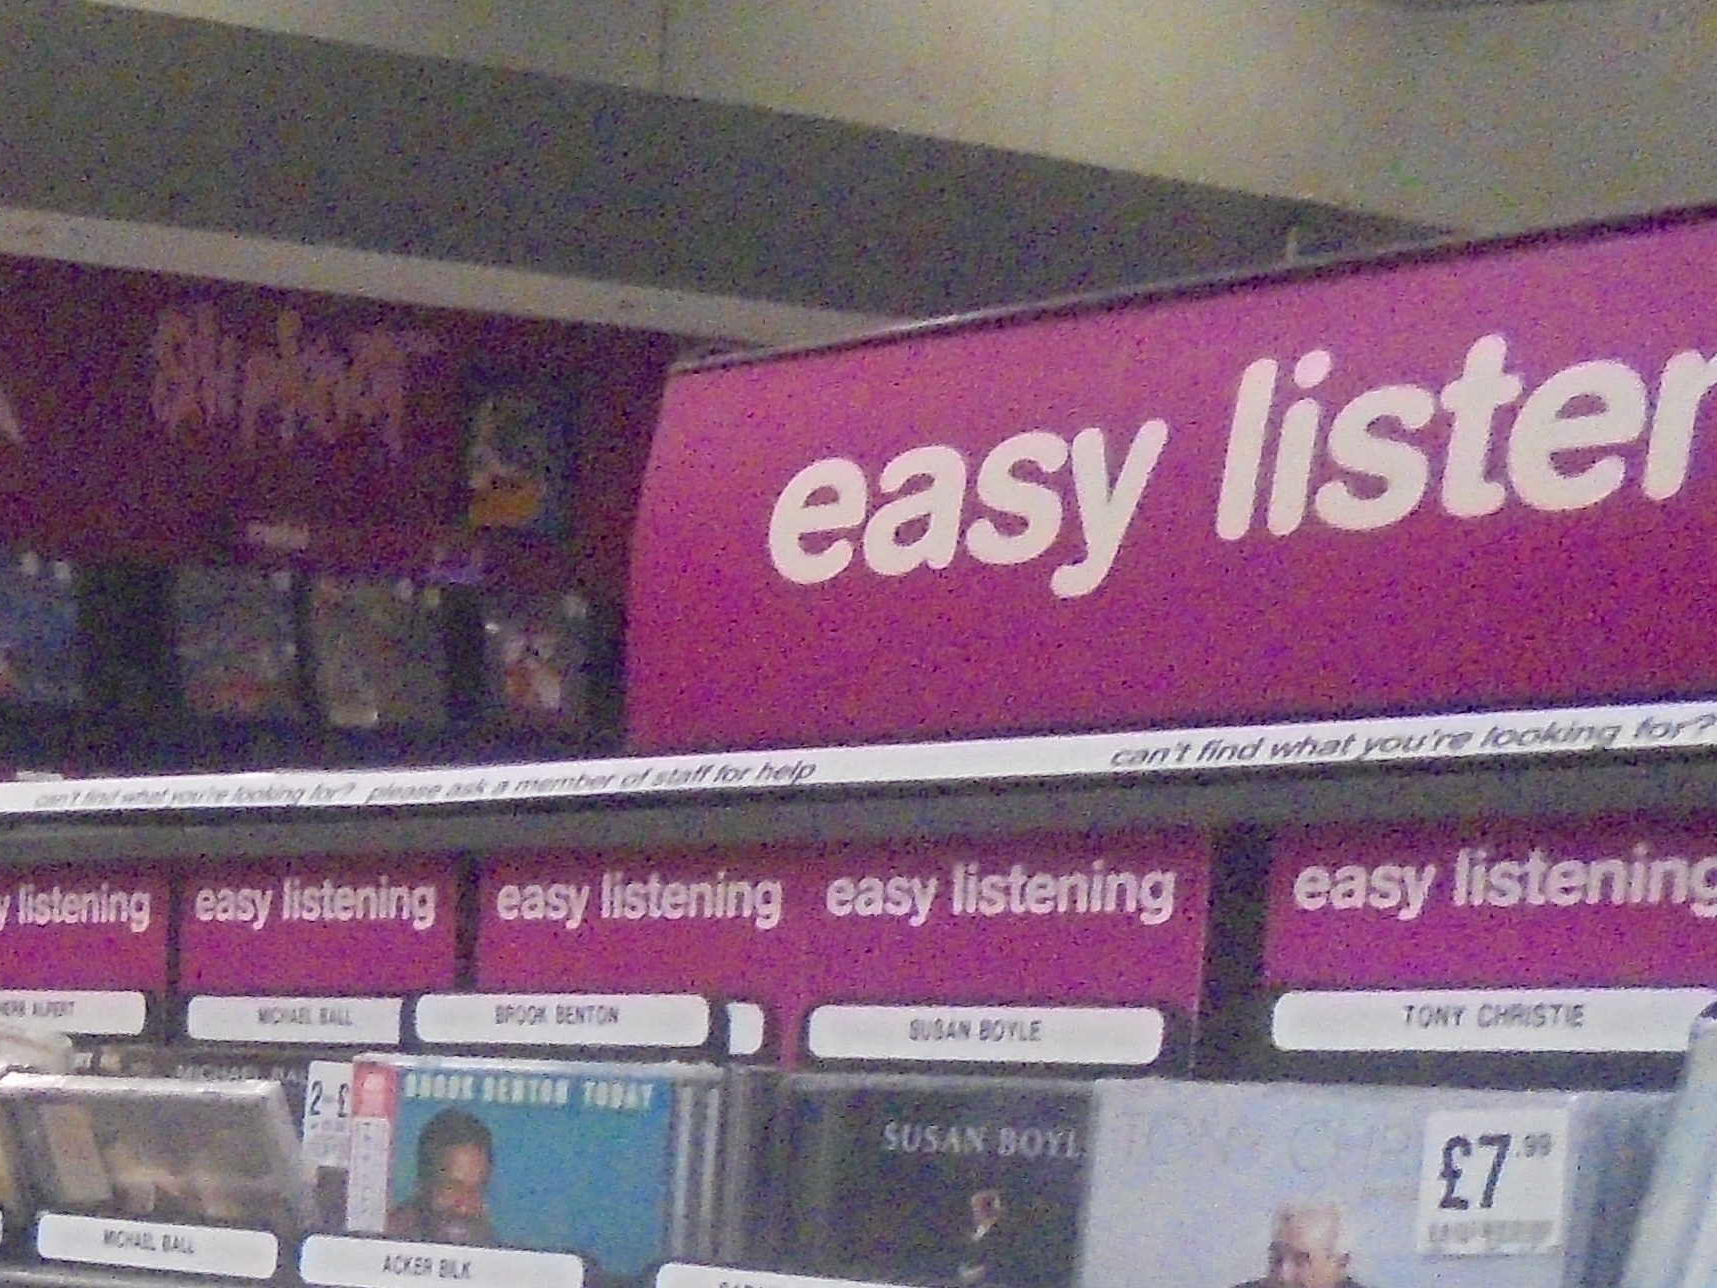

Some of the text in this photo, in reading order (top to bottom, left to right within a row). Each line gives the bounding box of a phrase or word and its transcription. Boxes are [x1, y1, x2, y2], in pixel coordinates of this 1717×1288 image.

[768, 421, 1167, 599] easy
[1110, 741, 1191, 769] can't
[1196, 738, 1264, 762] find
[1270, 733, 1357, 758] what
[1358, 728, 1472, 761] you're
[1479, 720, 1621, 749] looking
[365, 761, 817, 804] please ask a member of staff for help
[18, 883, 150, 933] listening
[196, 876, 436, 930] easy listening
[497, 871, 783, 930] easy listening
[826, 859, 1177, 926] easy listening
[495, 1005, 620, 1026] BROOK BENTON
[908, 1018, 1042, 1042] SUSAN BOYLE
[1404, 1002, 1585, 1029] TONY CHRISTIE
[104, 1230, 195, 1254] MICHAEL BALL
[382, 1255, 472, 1281] ACKER BILK
